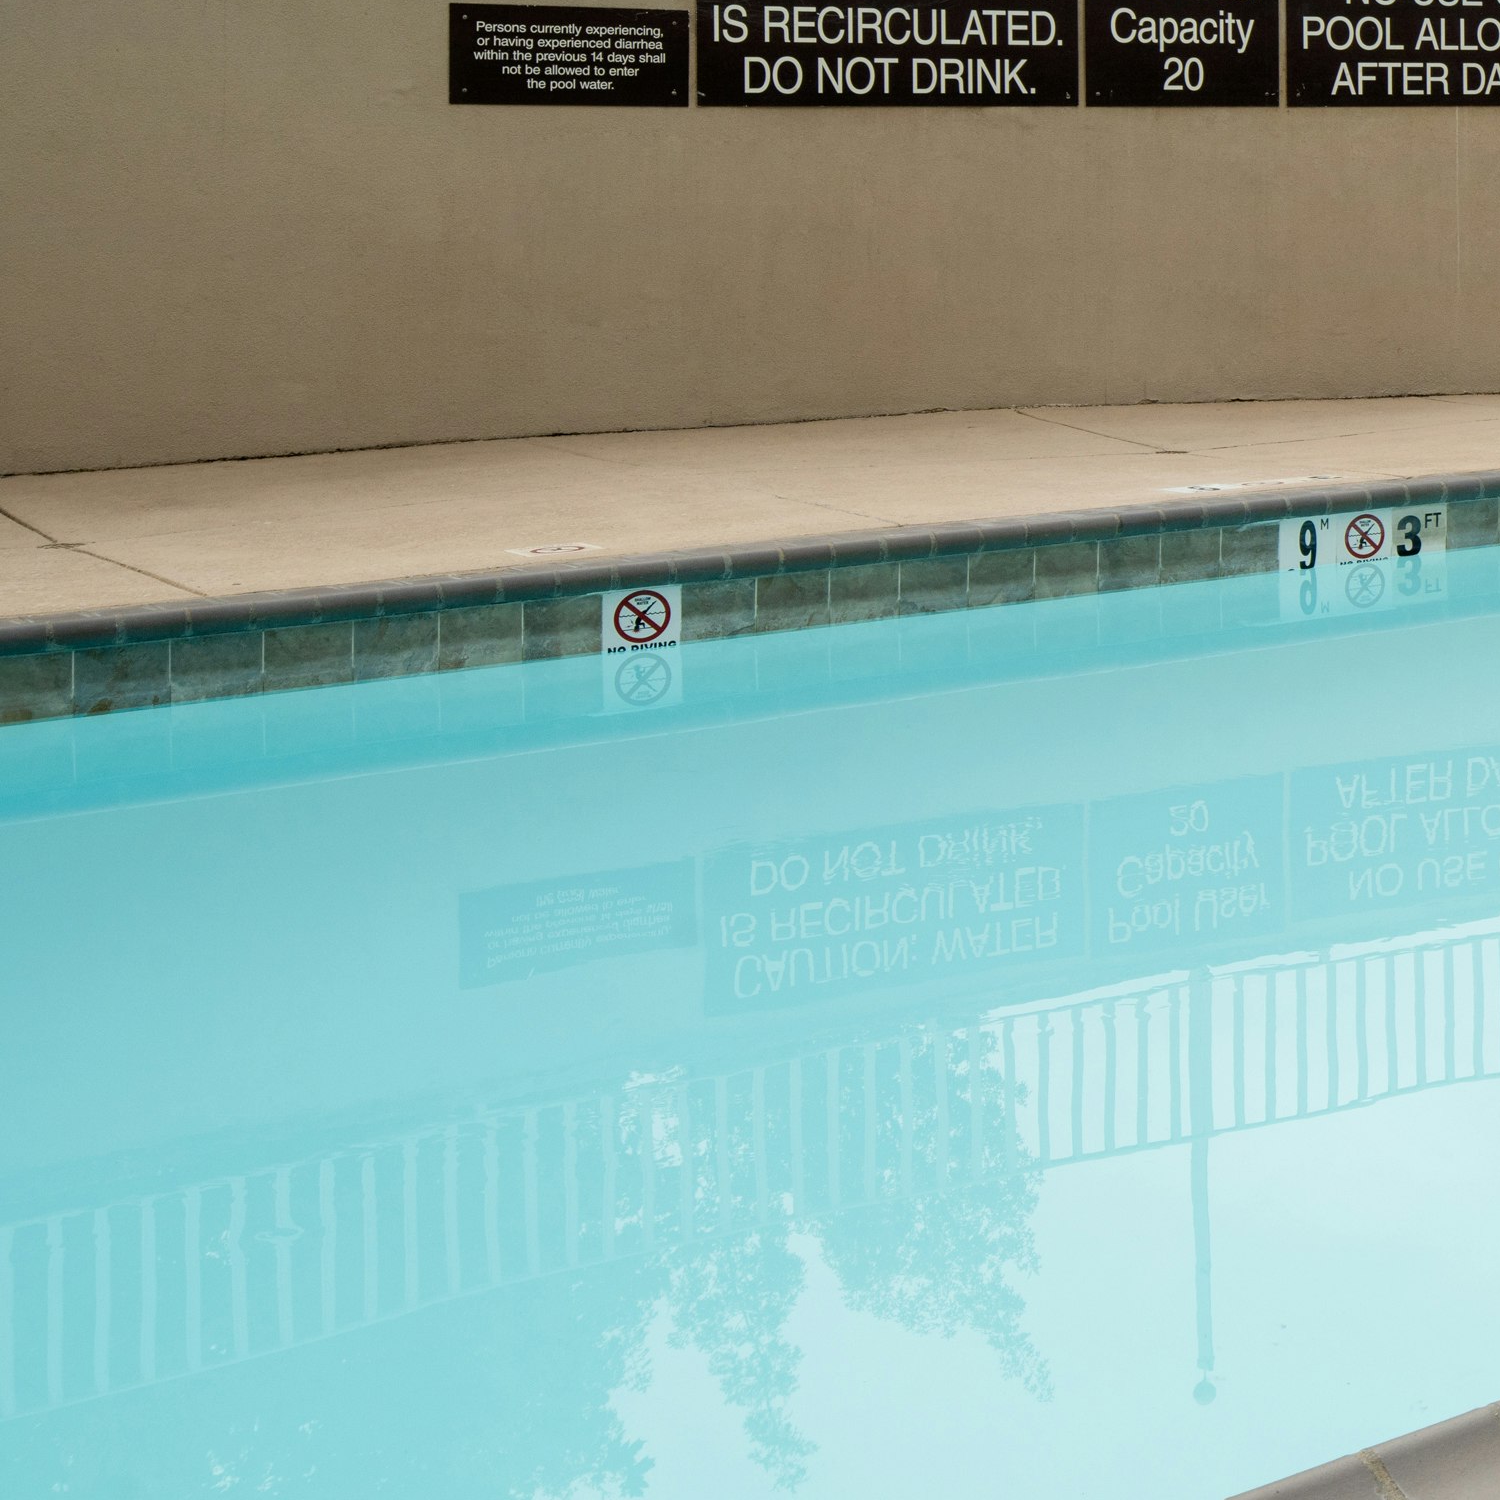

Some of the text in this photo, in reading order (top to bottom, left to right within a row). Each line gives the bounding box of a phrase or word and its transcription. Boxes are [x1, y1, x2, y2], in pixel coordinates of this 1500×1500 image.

[476, 21, 664, 39] Persons currently experiencing,
[713, 4, 1063, 46] IS RECIRCULATED.
[1110, 7, 1255, 54] Capacity
[1303, 16, 1404, 51] POOL
[473, 49, 666, 65] within the previous 14 days shall
[477, 35, 663, 50] or having experienced diarrhea
[502, 64, 640, 77] not be allowed to enter
[526, 78, 614, 91] the pool water.
[744, 56, 1036, 95] DO NOT DRINK.
[1163, 57, 1204, 91] 20
[1331, 62, 1450, 95] AFTER
[1320, 518, 1329, 530] M
[1396, 515, 1422, 557] 3
[1425, 512, 1442, 528] FT
